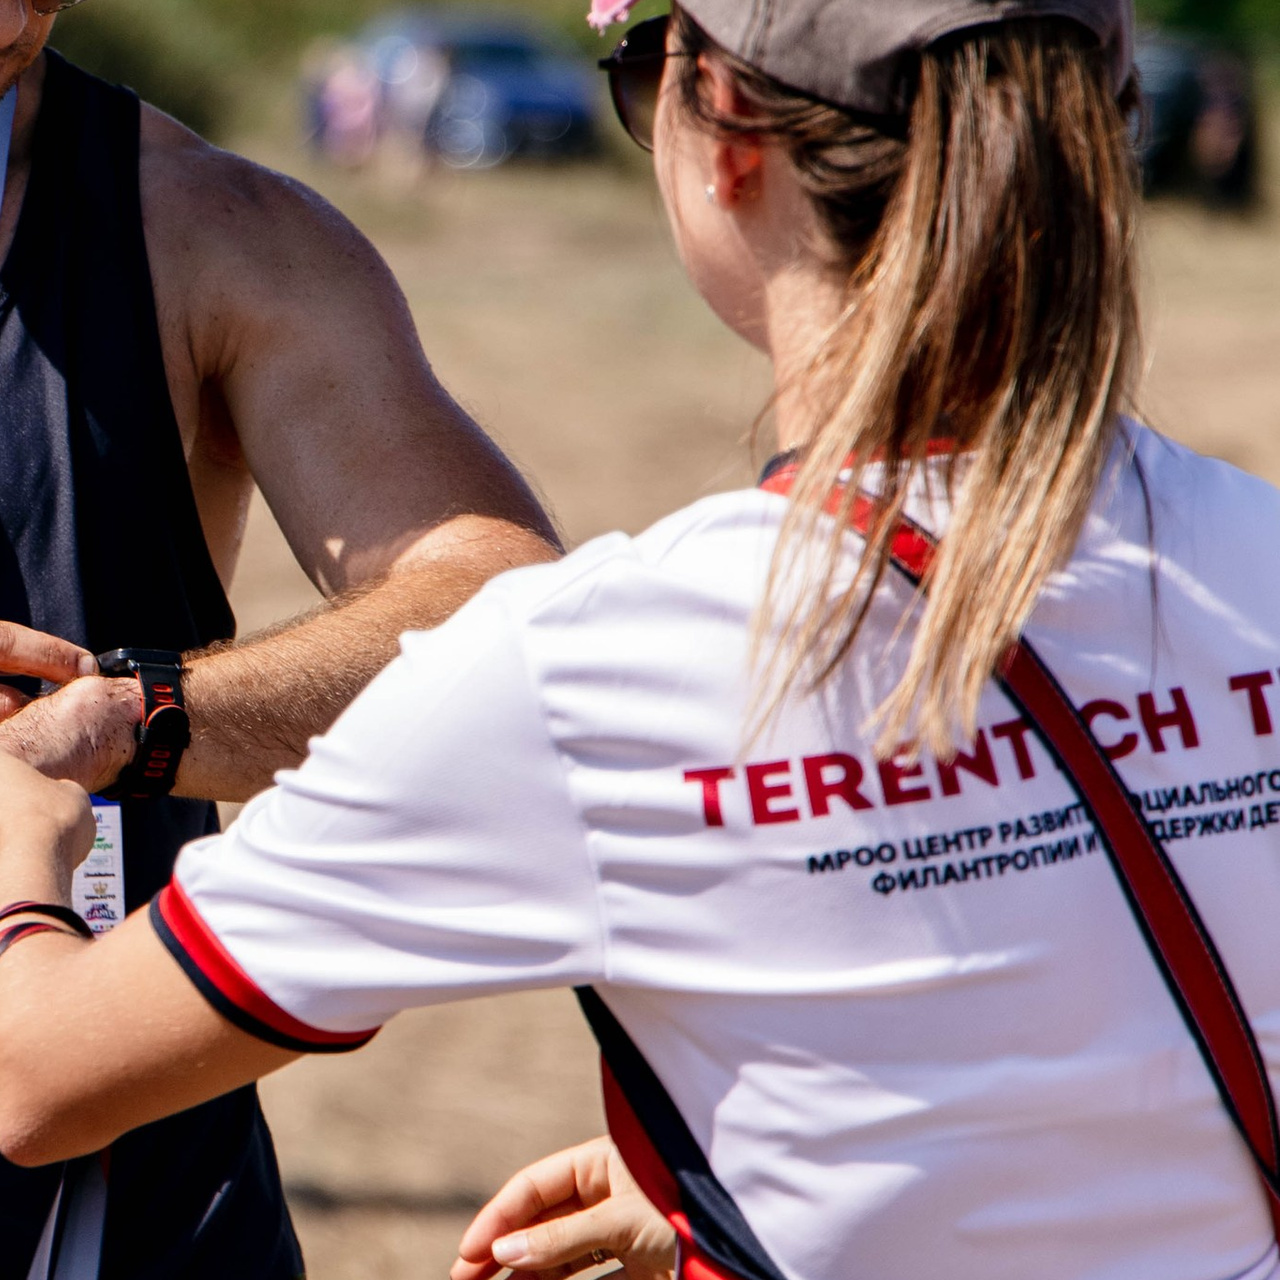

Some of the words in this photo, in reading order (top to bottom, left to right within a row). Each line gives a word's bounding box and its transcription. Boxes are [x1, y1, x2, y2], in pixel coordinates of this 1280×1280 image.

[683, 686, 1200, 829] TERENTCH
[1229, 668, 1280, 737] T
[808, 842, 896, 874] МРОО
[903, 826, 993, 861] ЦЕНТР
[998, 801, 1087, 842] РАЗВИТ
[873, 835, 1081, 896] ФИЛАНТРОПИИ
[1148, 809, 1245, 842] ДЕРЖКИ
[1250, 802, 1280, 830] ДЕ
